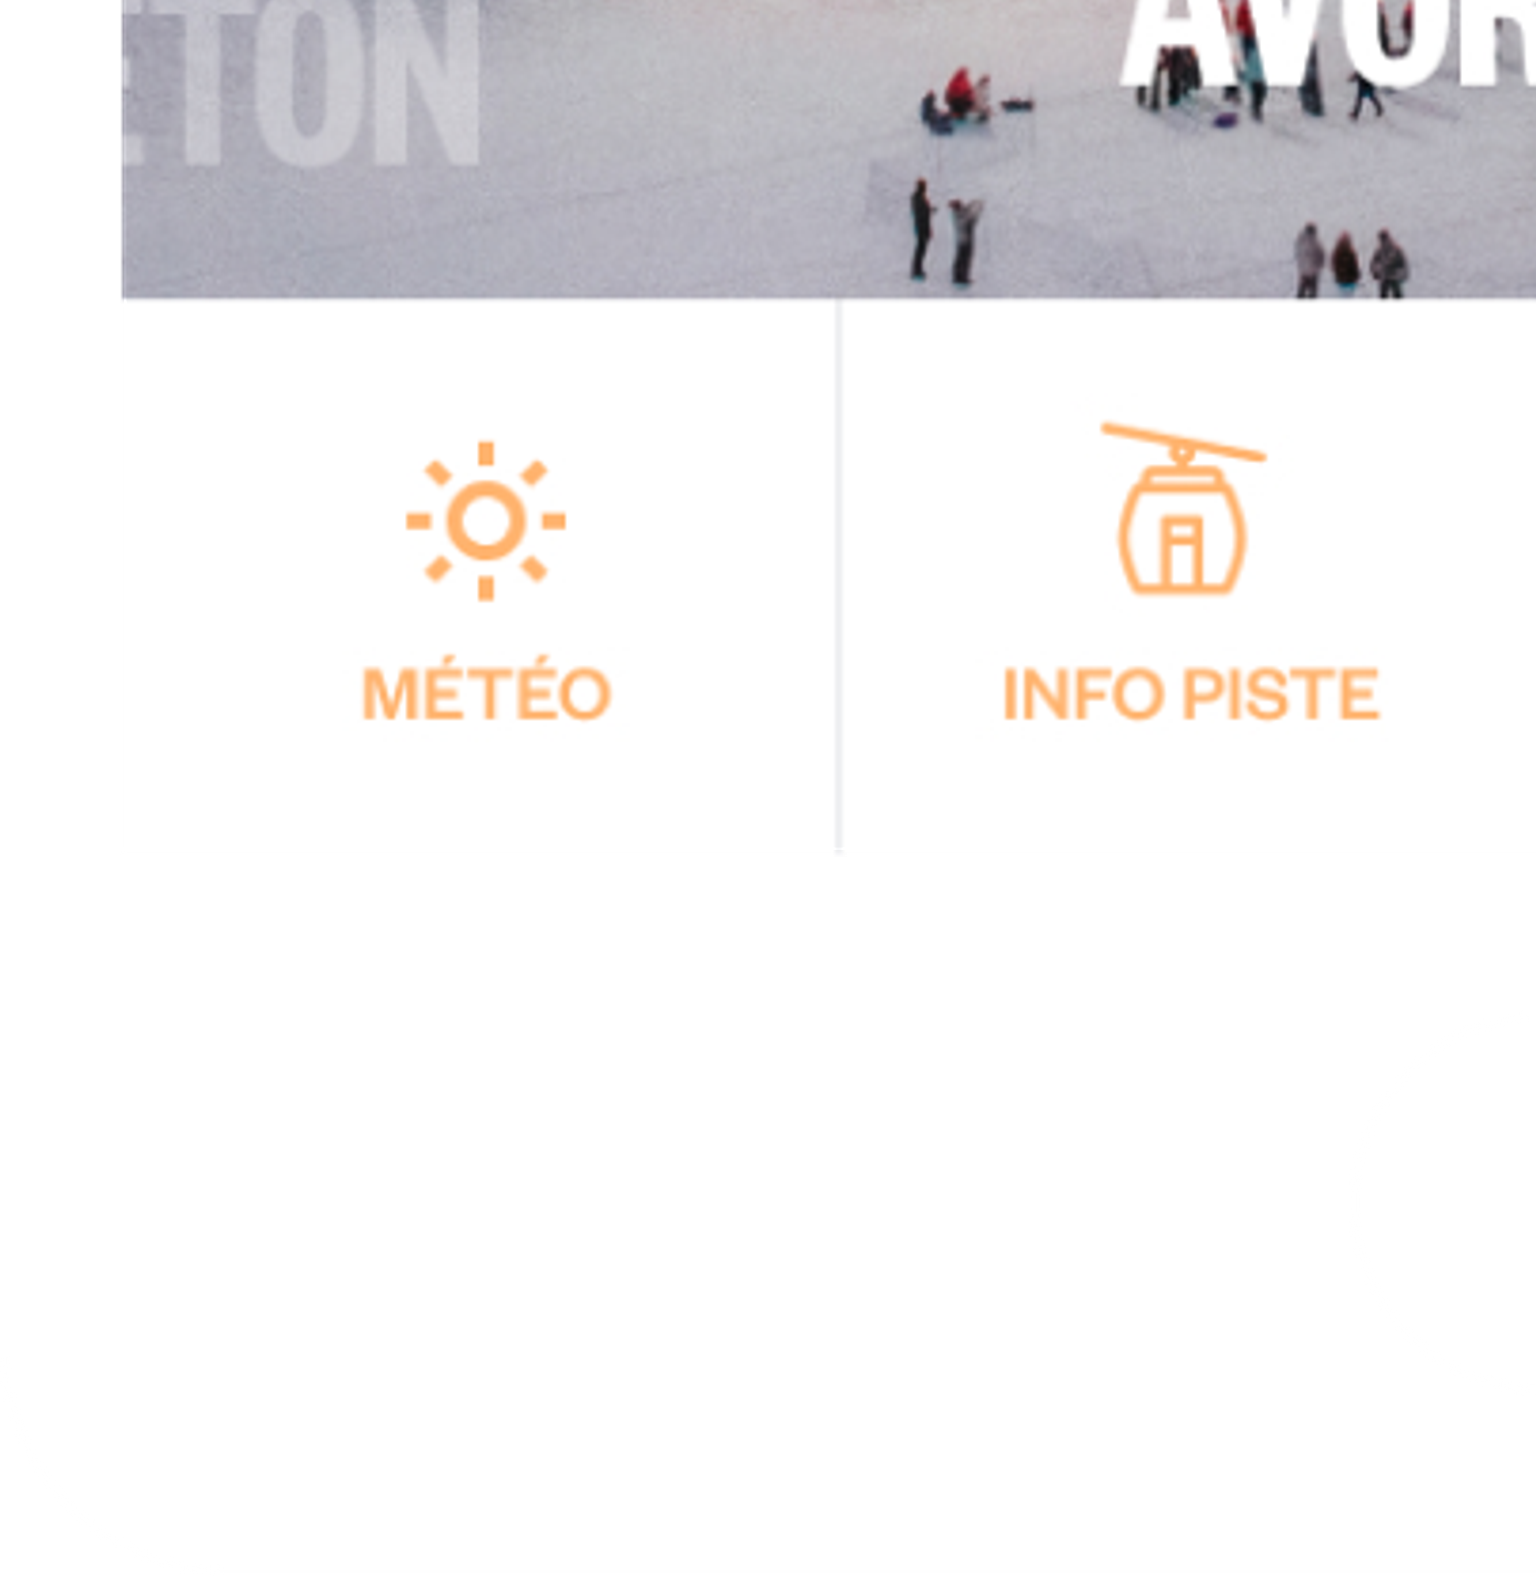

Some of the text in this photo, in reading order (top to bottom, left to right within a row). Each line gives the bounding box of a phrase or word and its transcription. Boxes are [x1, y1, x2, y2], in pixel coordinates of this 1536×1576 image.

[362, 653, 612, 722] MÉTÉO
[1003, 665, 1381, 722] INFO PISTE
